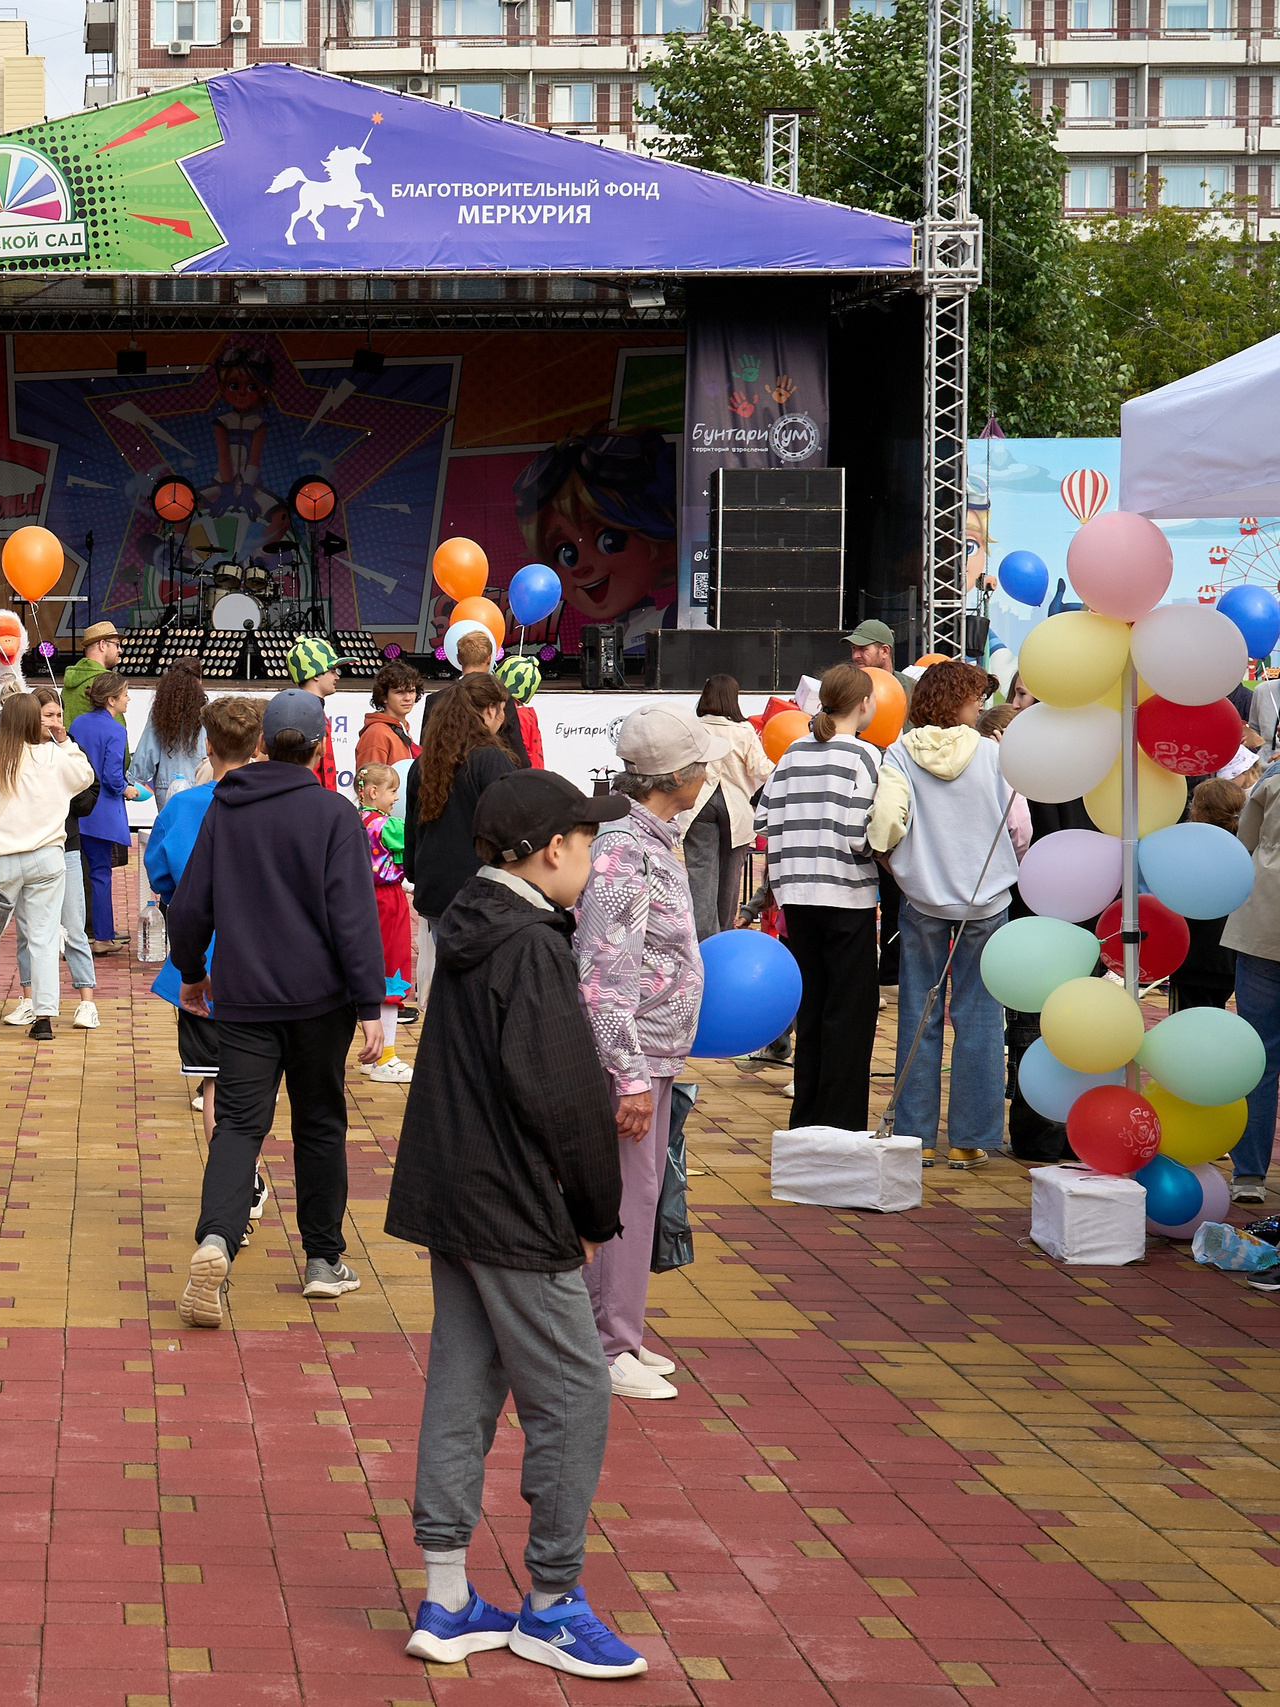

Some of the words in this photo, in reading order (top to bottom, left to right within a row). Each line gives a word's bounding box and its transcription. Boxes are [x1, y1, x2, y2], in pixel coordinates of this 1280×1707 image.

[391, 179, 600, 198] БЛАГОТВОРИТЕЛЬНЫЙ
[604, 181, 660, 200] ФОНД
[457, 204, 591, 224] МЕРКУРИЯ
[45, 232, 83, 248] САД
[555, 723, 607, 738] Бунтари
